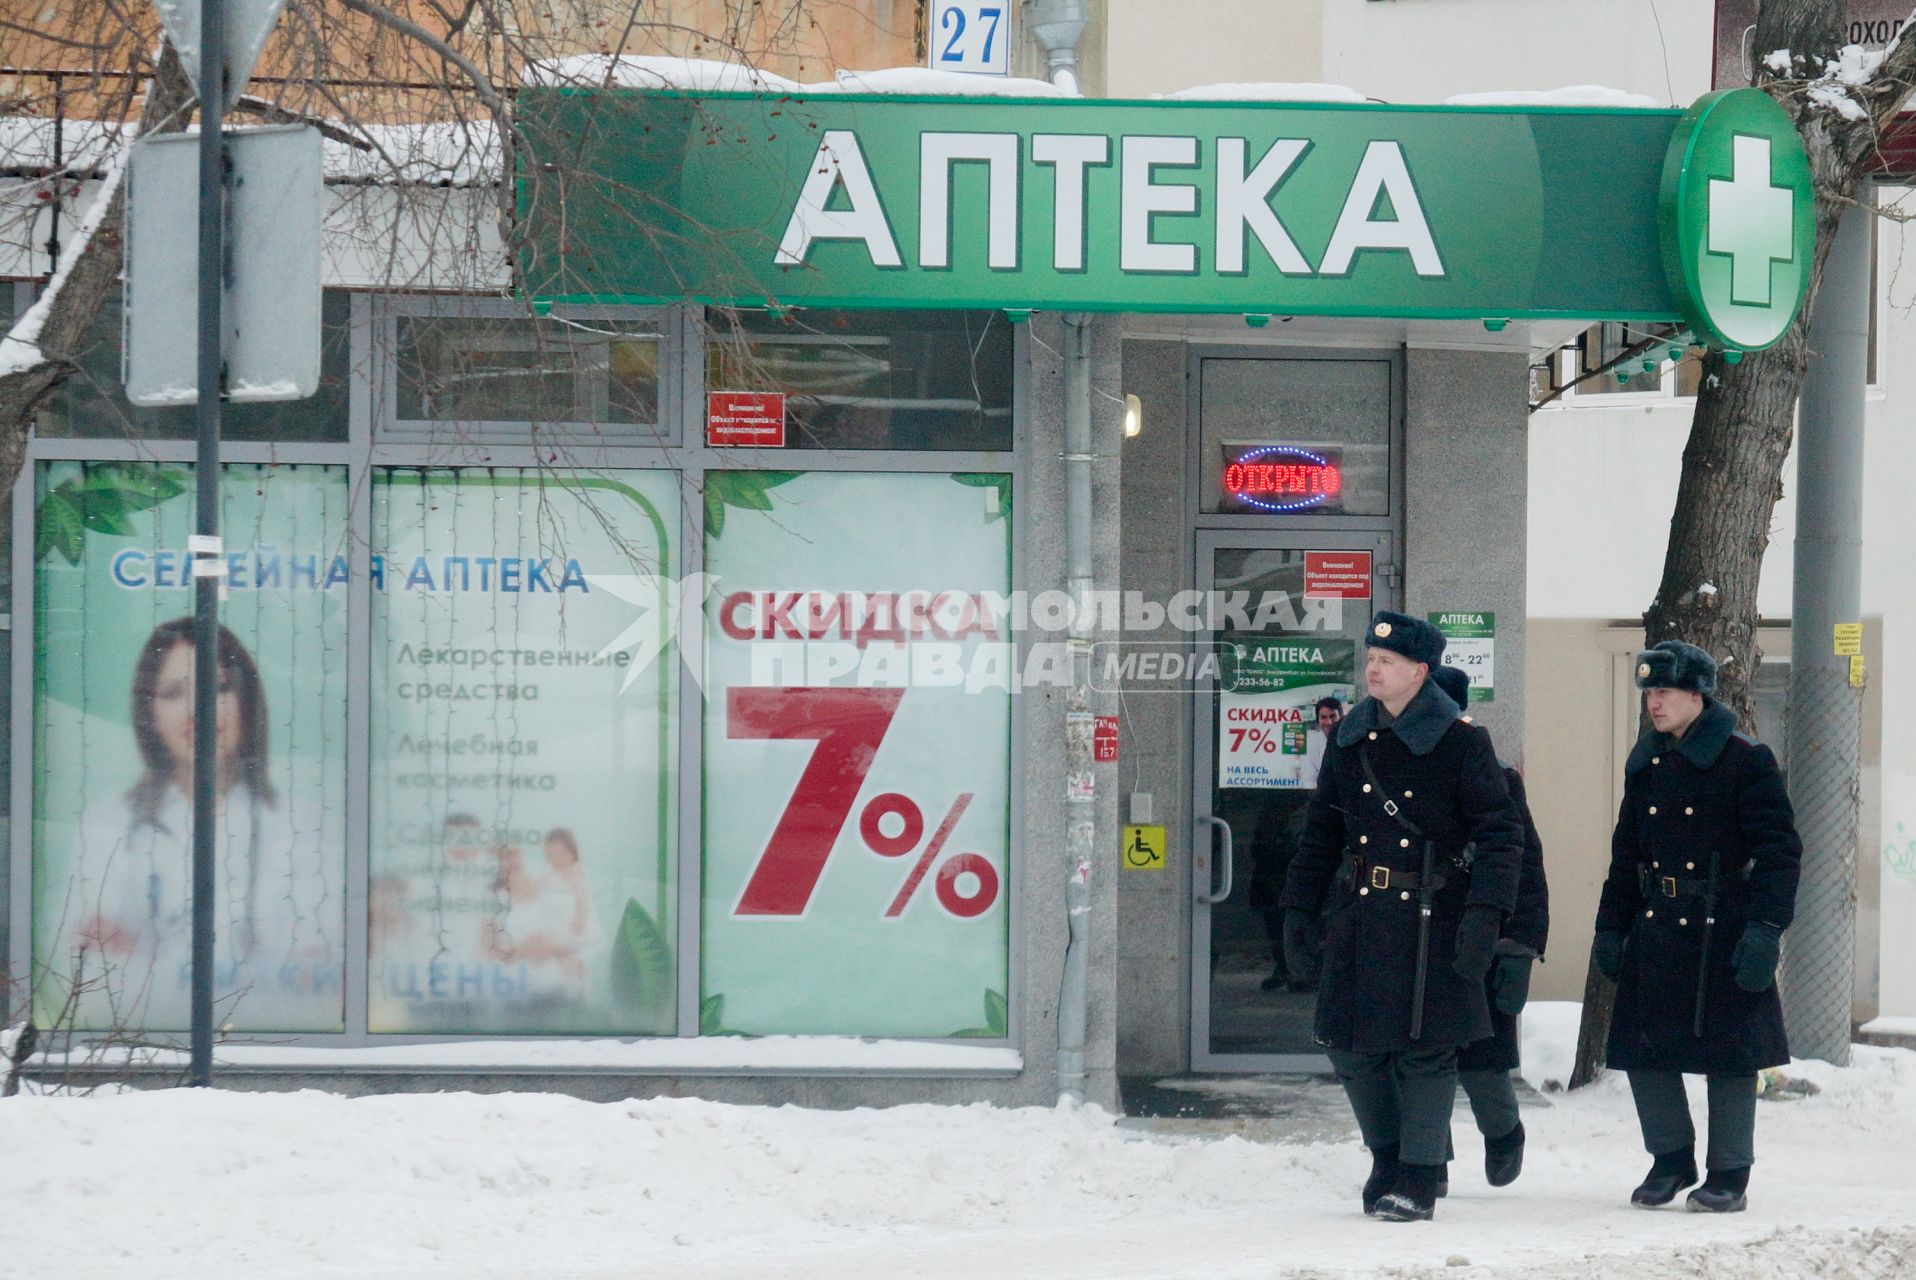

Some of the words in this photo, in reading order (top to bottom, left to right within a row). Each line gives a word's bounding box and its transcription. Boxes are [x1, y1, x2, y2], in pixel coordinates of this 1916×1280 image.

[941, 6, 1001, 63] 27
[773, 130, 1446, 277] АПТЕКА
[1226, 464, 1338, 494] ОТКРЫТО
[113, 544, 384, 592] СЕЕЙНАЯ
[404, 556, 590, 594] АПТЕКА
[719, 591, 1000, 650] СКИДКА
[1439, 614, 1485, 625] АПТЕКА
[397, 643, 630, 670] Лекарственные
[1253, 647, 1324, 663] АПТЕКА
[397, 682, 539, 703] средства
[1227, 708, 1302, 724] СКИДКА
[1229, 728, 1277, 753] 7%
[1226, 778, 1301, 786] АССОРТИМЕНТ
[1227, 766, 1241, 774] НА
[1244, 766, 1268, 775] ВЕСЬ
[727, 687, 999, 917] 7%
